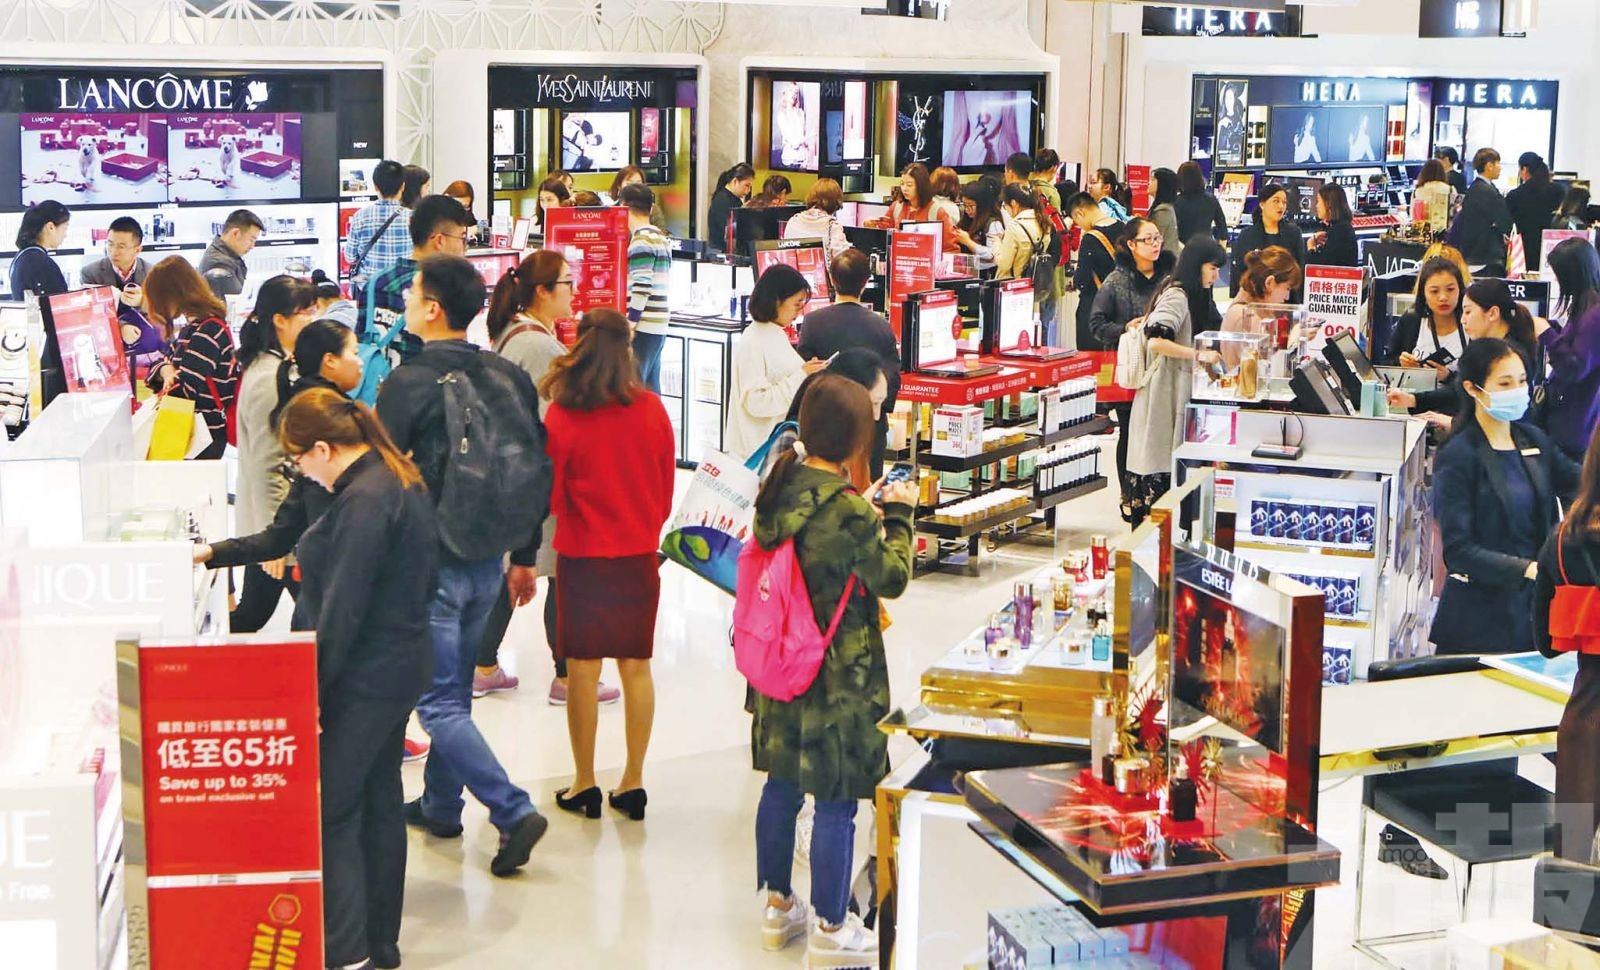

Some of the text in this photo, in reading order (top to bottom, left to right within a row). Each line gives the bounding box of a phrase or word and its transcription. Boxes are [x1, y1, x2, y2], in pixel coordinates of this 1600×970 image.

[1175, 9, 1272, 31] HERA
[57, 73, 234, 110] LANCÔME
[1302, 82, 1360, 101] HERA
[1448, 83, 1538, 104] HERA
[1309, 281, 1358, 295] 價格保證
[1508, 284, 1526, 298] ER
[1308, 303, 1357, 315] GUARANTEE
[1309, 294, 1358, 305] PRICE MATCH
[903, 384, 940, 393] GUARANTEE
[157, 735, 298, 770] 低至65折
[159, 773, 287, 792] Save up to 35%
[160, 791, 275, 803] on travel exclusive set
[0, 810, 53, 868] E
